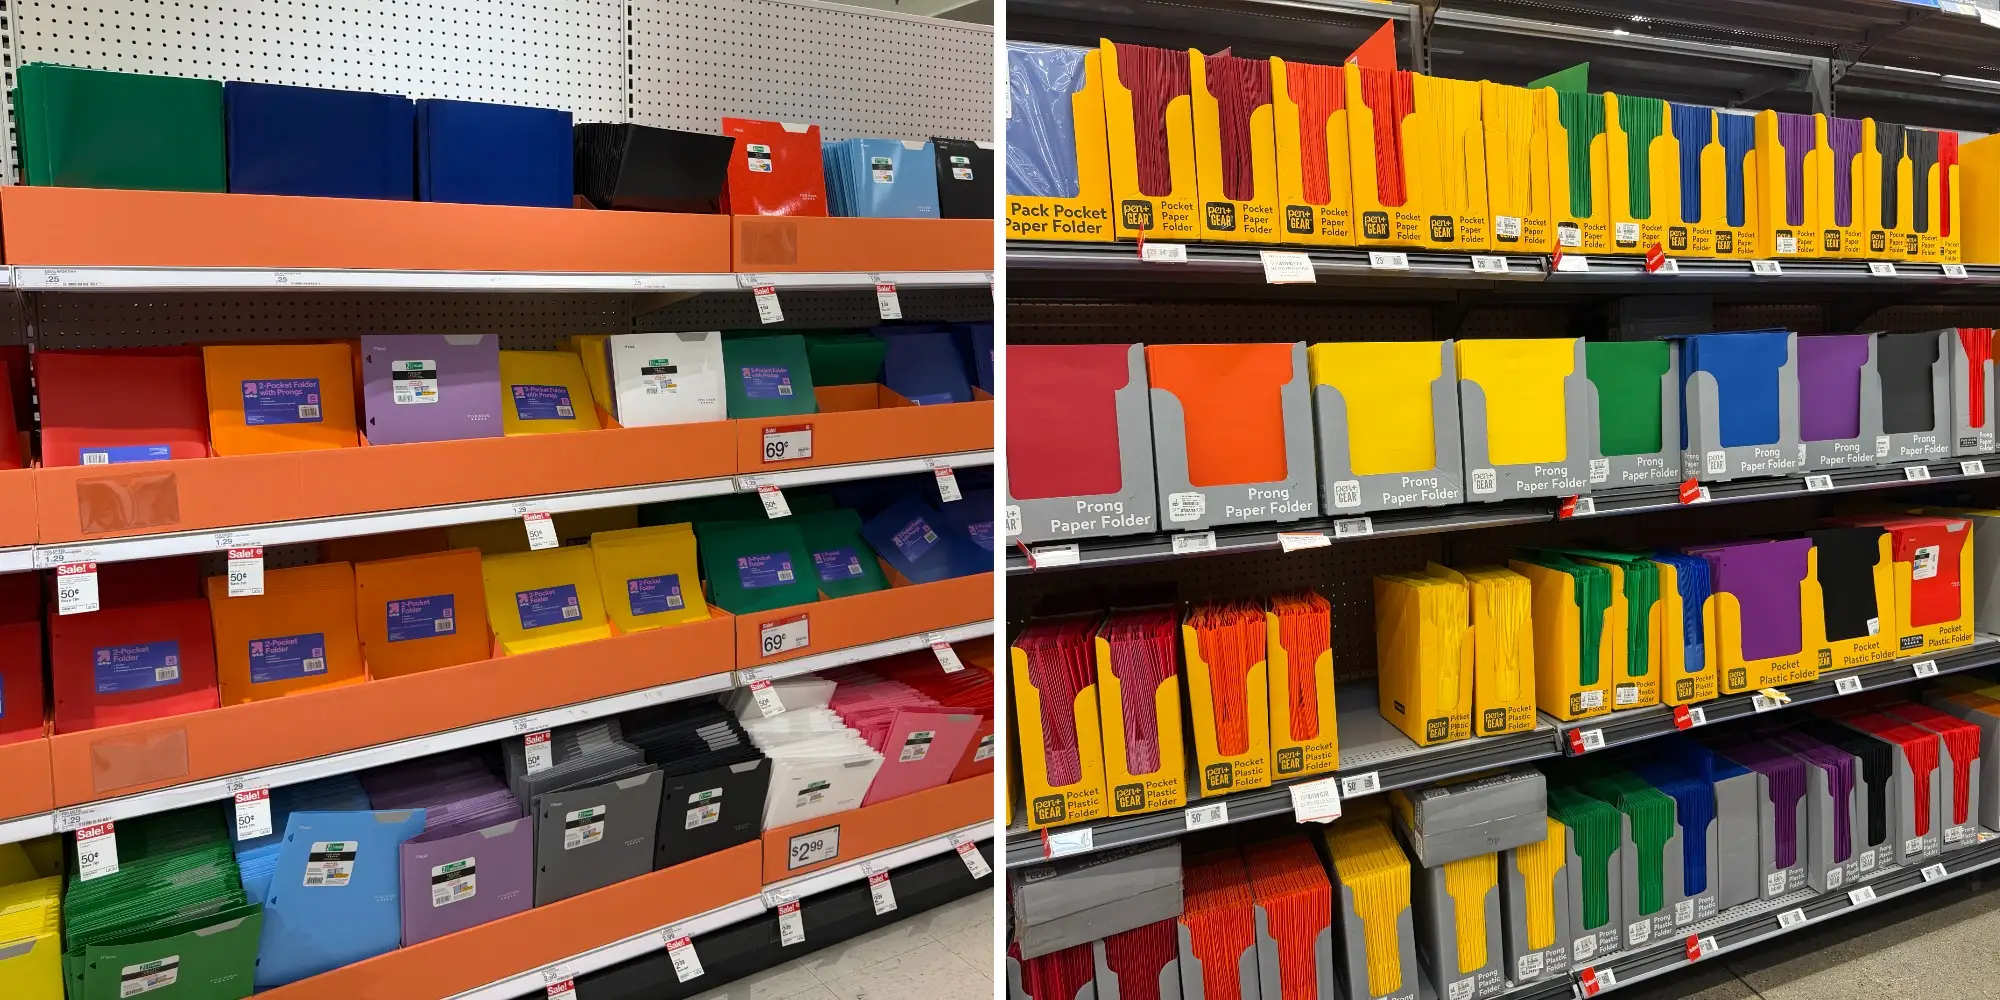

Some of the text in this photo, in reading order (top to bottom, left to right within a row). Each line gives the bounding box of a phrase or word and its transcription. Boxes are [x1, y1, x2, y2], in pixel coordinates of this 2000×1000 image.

[1161, 201, 1193, 210] Pocket
[1243, 204, 1273, 214] Pocket
[1011, 203, 1107, 219] Pack Pocket
[1321, 208, 1348, 216] Pocket
[1162, 212, 1188, 222] Paper
[1244, 215, 1269, 224] Paper
[1396, 212, 1421, 221] Pocket
[1460, 216, 1484, 224] Pocket
[1053, 220, 1102, 234] Folder
[1163, 222, 1193, 232] Folder
[1322, 218, 1344, 227] Paper
[1396, 222, 1418, 231] Paper
[1524, 218, 1546, 226] Pocket
[1244, 225, 1272, 234] Folder
[1322, 228, 1348, 236] Folder
[1461, 226, 1481, 235] Paper
[1524, 228, 1544, 236] Paper
[1642, 224, 1663, 232] Pocket
[1398, 232, 1421, 240] Folder
[1462, 235, 1484, 243] Folder
[1525, 236, 1546, 244] Folder
[1584, 232, 1603, 240] Paper
[1642, 233, 1660, 241] Paper
[1692, 236, 1709, 244] Paper
[294, 381, 316, 389] Folder
[276, 389, 302, 397] Prongs
[1913, 435, 1936, 445] Prong
[765, 441, 789, 458] 69¢
[1835, 443, 1860, 454] Prong
[1901, 444, 1948, 456] Paper Folder
[1755, 449, 1780, 460] Prong
[1820, 453, 1873, 466] Paper Folder
[1637, 457, 1663, 468] Prong
[1741, 458, 1796, 473] Paper Folder
[1535, 466, 1568, 478] Prong
[1622, 468, 1678, 482] Paper Folder
[1402, 476, 1438, 489] Prong
[1517, 478, 1586, 492] Paper Folder
[1248, 488, 1289, 500] Prong
[1383, 488, 1458, 506] Paper Folder
[1076, 500, 1123, 514] Prong
[1226, 501, 1312, 520] Paper Folder
[524, 513, 544, 521] Sale!
[1051, 514, 1150, 534] Paper Folder
[229, 549, 254, 559] Sale!
[58, 565, 86, 575] Sale!
[230, 573, 247, 581] 50¢
[60, 589, 79, 599] 50¢
[529, 590, 556, 598] 2-Pocket
[401, 599, 430, 608] 2-Pocket
[401, 607, 423, 615] Folder
[1939, 625, 1962, 634] Pocket
[265, 639, 298, 647] 2-Pocket
[764, 633, 786, 652] 69¢
[1929, 633, 1972, 647] Plastic Folder
[113, 647, 149, 655] 2-Pocket
[1854, 641, 1880, 652] Pocket
[114, 654, 139, 662] Folder
[1844, 650, 1896, 665] Plastic Folder
[1771, 660, 1800, 670] Pocket
[1696, 674, 1714, 682] Pocket
[1760, 668, 1816, 685] Plastic Folder
[750, 682, 766, 691] Sale!
[1696, 682, 1714, 690] Plastic
[1508, 705, 1531, 713] Pocket
[1508, 713, 1531, 721] Plastic
[526, 735, 544, 745] Sale!
[1305, 742, 1333, 752] Pocket
[528, 756, 540, 765] 50¢
[1306, 751, 1332, 761] Plastic
[1234, 758, 1264, 768] Pocket
[1306, 760, 1331, 770] Folder
[1235, 767, 1263, 777] Plastic
[227, 783, 243, 791] 1.29
[1146, 778, 1177, 788] Pocket
[1235, 777, 1263, 787] Folder
[236, 793, 260, 803] Sale!
[1067, 788, 1099, 799] Pocket
[1147, 788, 1177, 798] Plastic
[1068, 798, 1099, 809] Plastic
[1148, 798, 1177, 808] Folder
[1068, 808, 1099, 819] Folder
[62, 816, 81, 825] 1.29
[238, 815, 255, 825] 50¢
[78, 827, 104, 840] Sale!
[81, 852, 99, 864] 50¢
[869, 875, 883, 885] Sale!
[778, 905, 794, 914] Sale!
[1654, 914, 1671, 924] Prong
[1654, 921, 1673, 930] Plastic
[1599, 929, 1616, 939] Prong
[1654, 928, 1672, 938] Folder
[667, 940, 685, 951] Sale!
[1600, 936, 1618, 945] Plastic
[1546, 947, 1564, 958] Prong
[1599, 944, 1618, 953] Folder
[1546, 955, 1567, 965] Plastic
[1546, 963, 1566, 972] Folder
[1478, 970, 1497, 980] Prong
[1479, 976, 1500, 988] Plastic
[548, 983, 567, 996] Sale!
[1479, 984, 1501, 996] Folder
